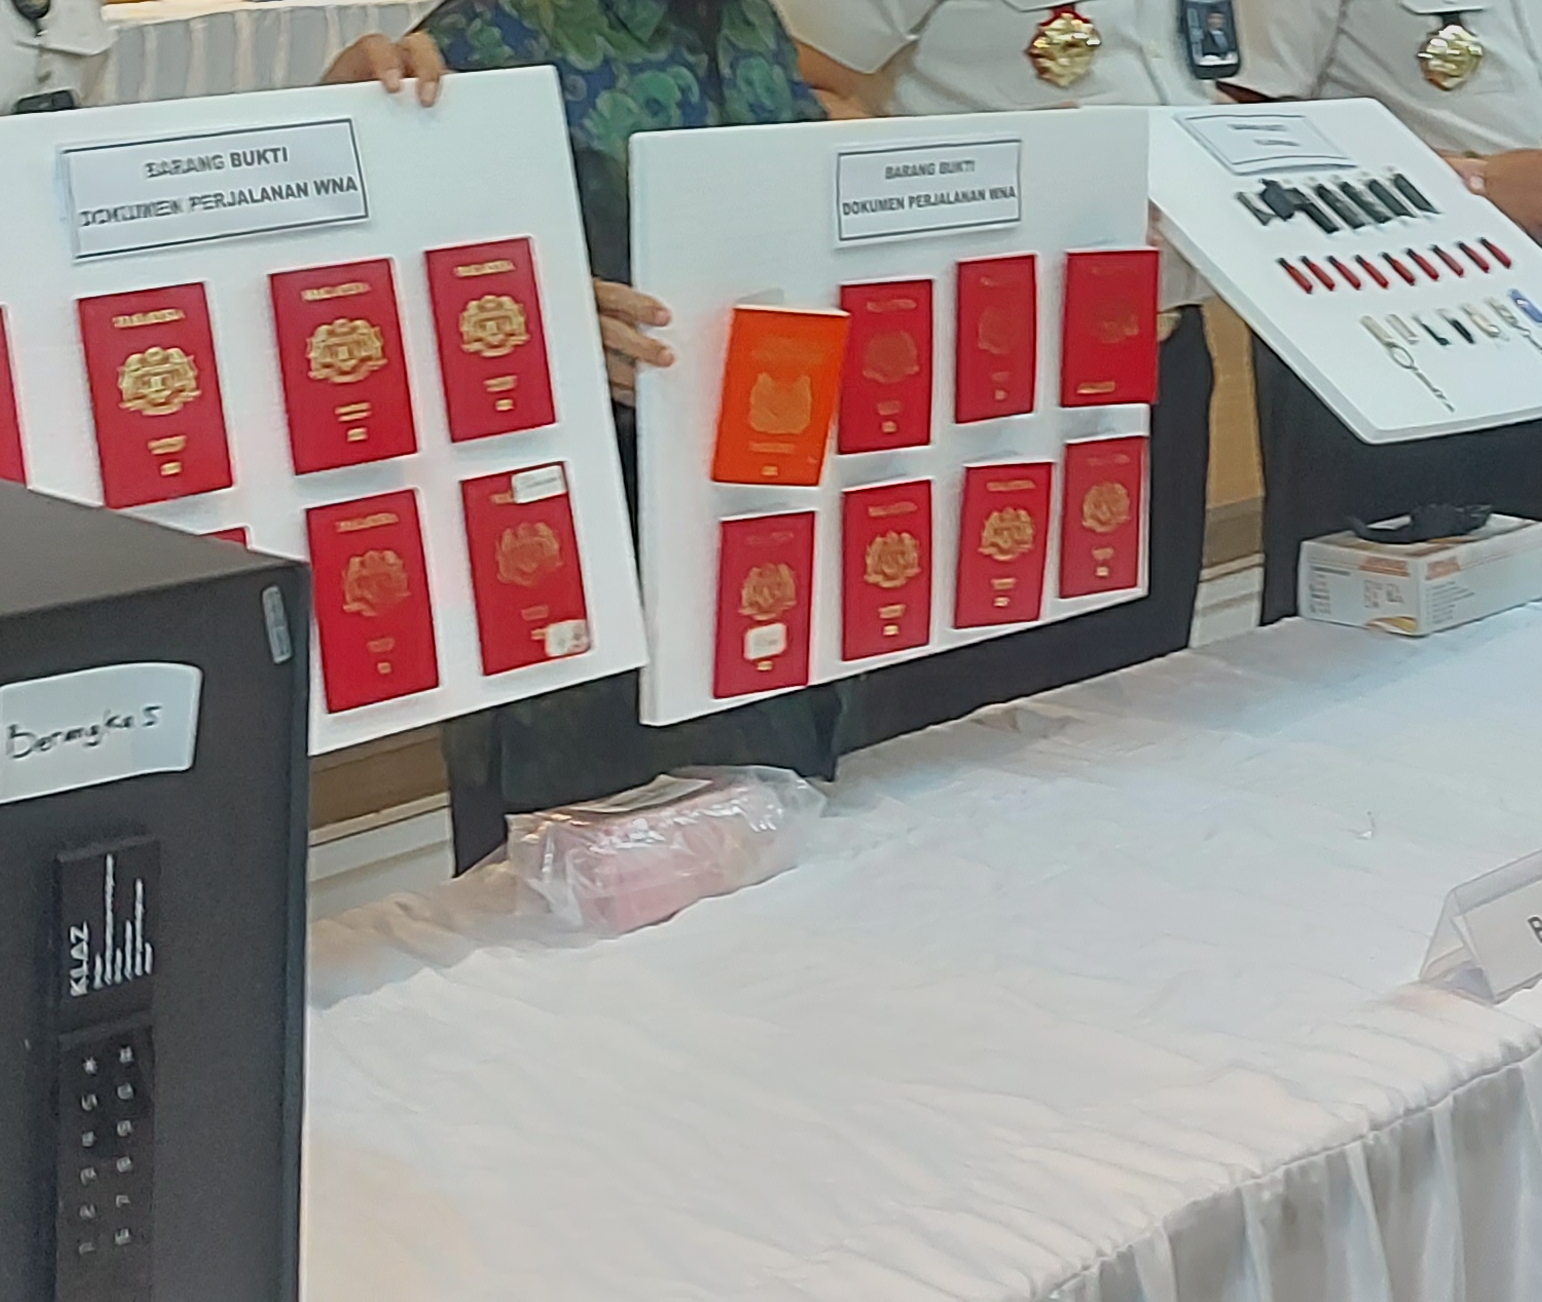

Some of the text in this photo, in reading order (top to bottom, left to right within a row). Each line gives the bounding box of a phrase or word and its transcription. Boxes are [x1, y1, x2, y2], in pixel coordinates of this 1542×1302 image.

[230, 147, 289, 169] BUKTI
[884, 160, 976, 180] BARANG BUKTI
[188, 182, 310, 212] PERJALANAN
[313, 175, 358, 197] WNA
[842, 185, 1017, 216] DOKUMEN PERJALANAN WNA
[69, 920, 89, 996] KLAZ
